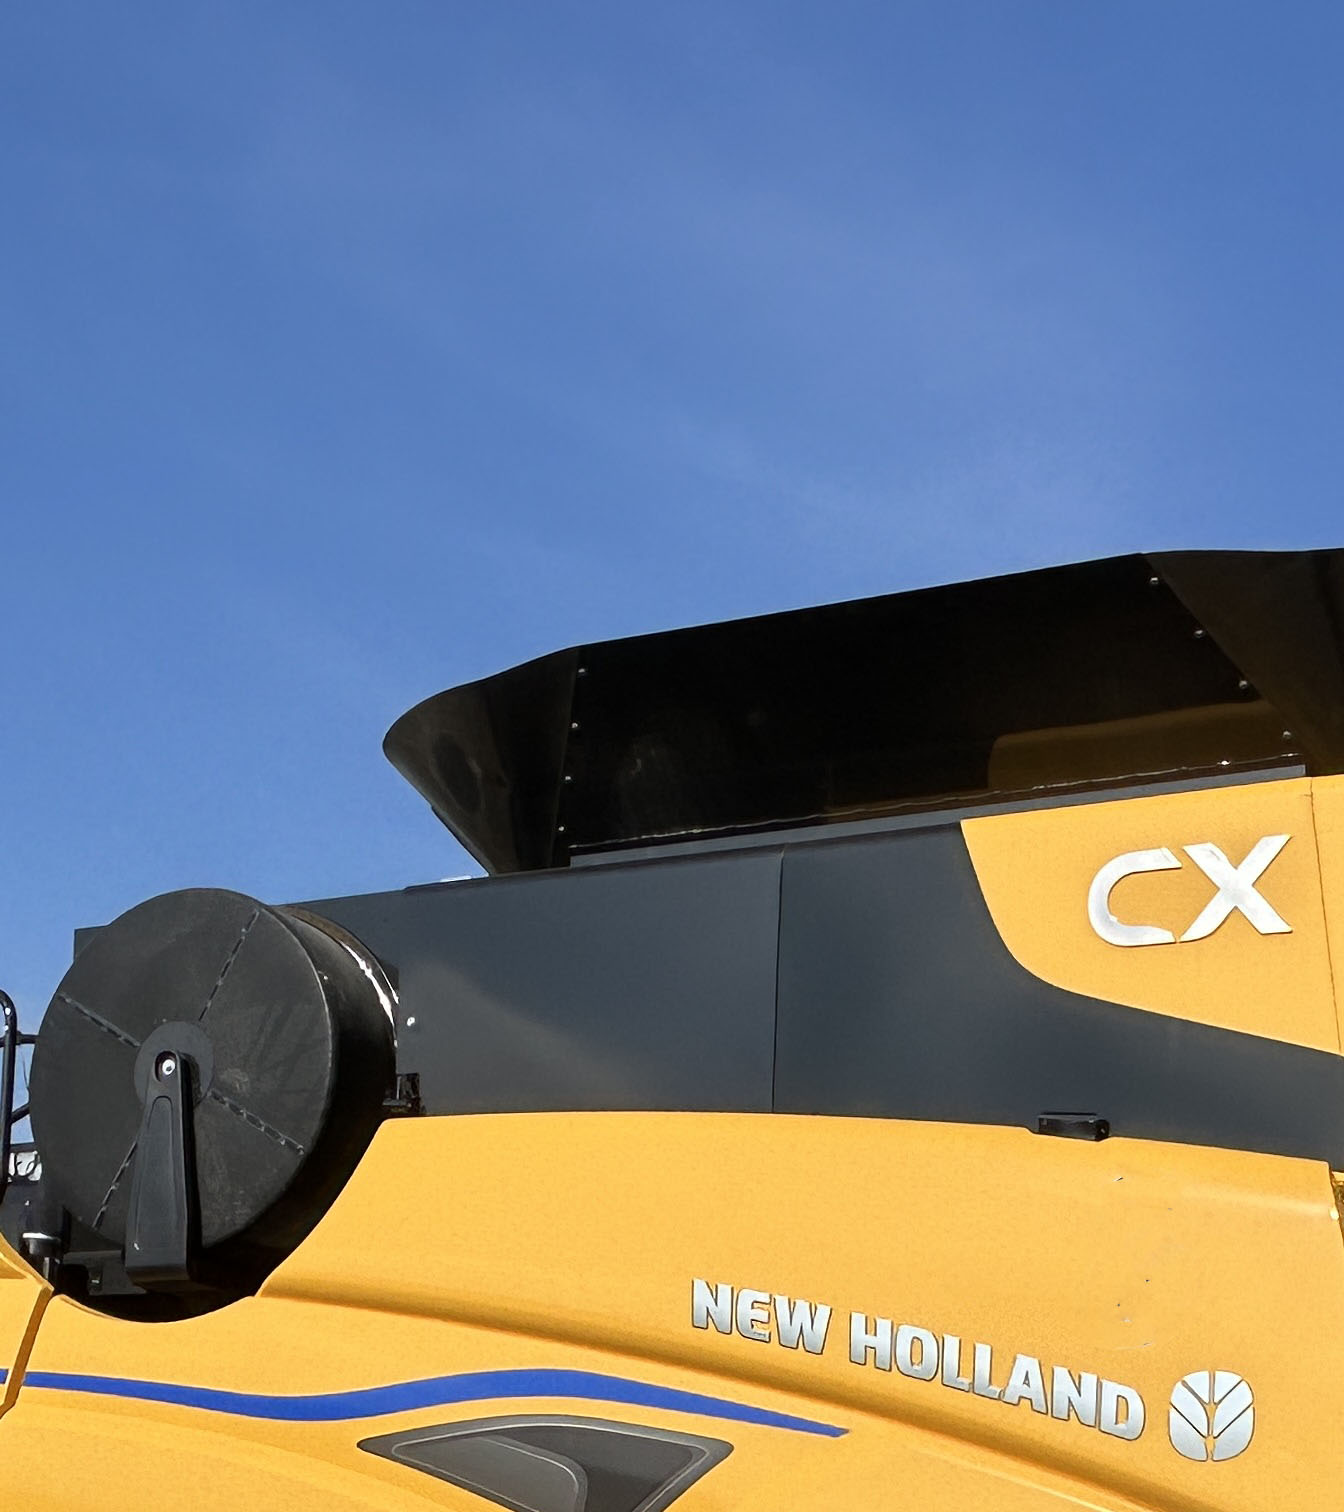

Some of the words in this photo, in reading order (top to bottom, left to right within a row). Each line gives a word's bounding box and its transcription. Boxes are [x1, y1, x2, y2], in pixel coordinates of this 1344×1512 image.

[1087, 833, 1293, 948] CX
[691, 1278, 832, 1355] NEW
[849, 1311, 1147, 1441] HOLLAND
